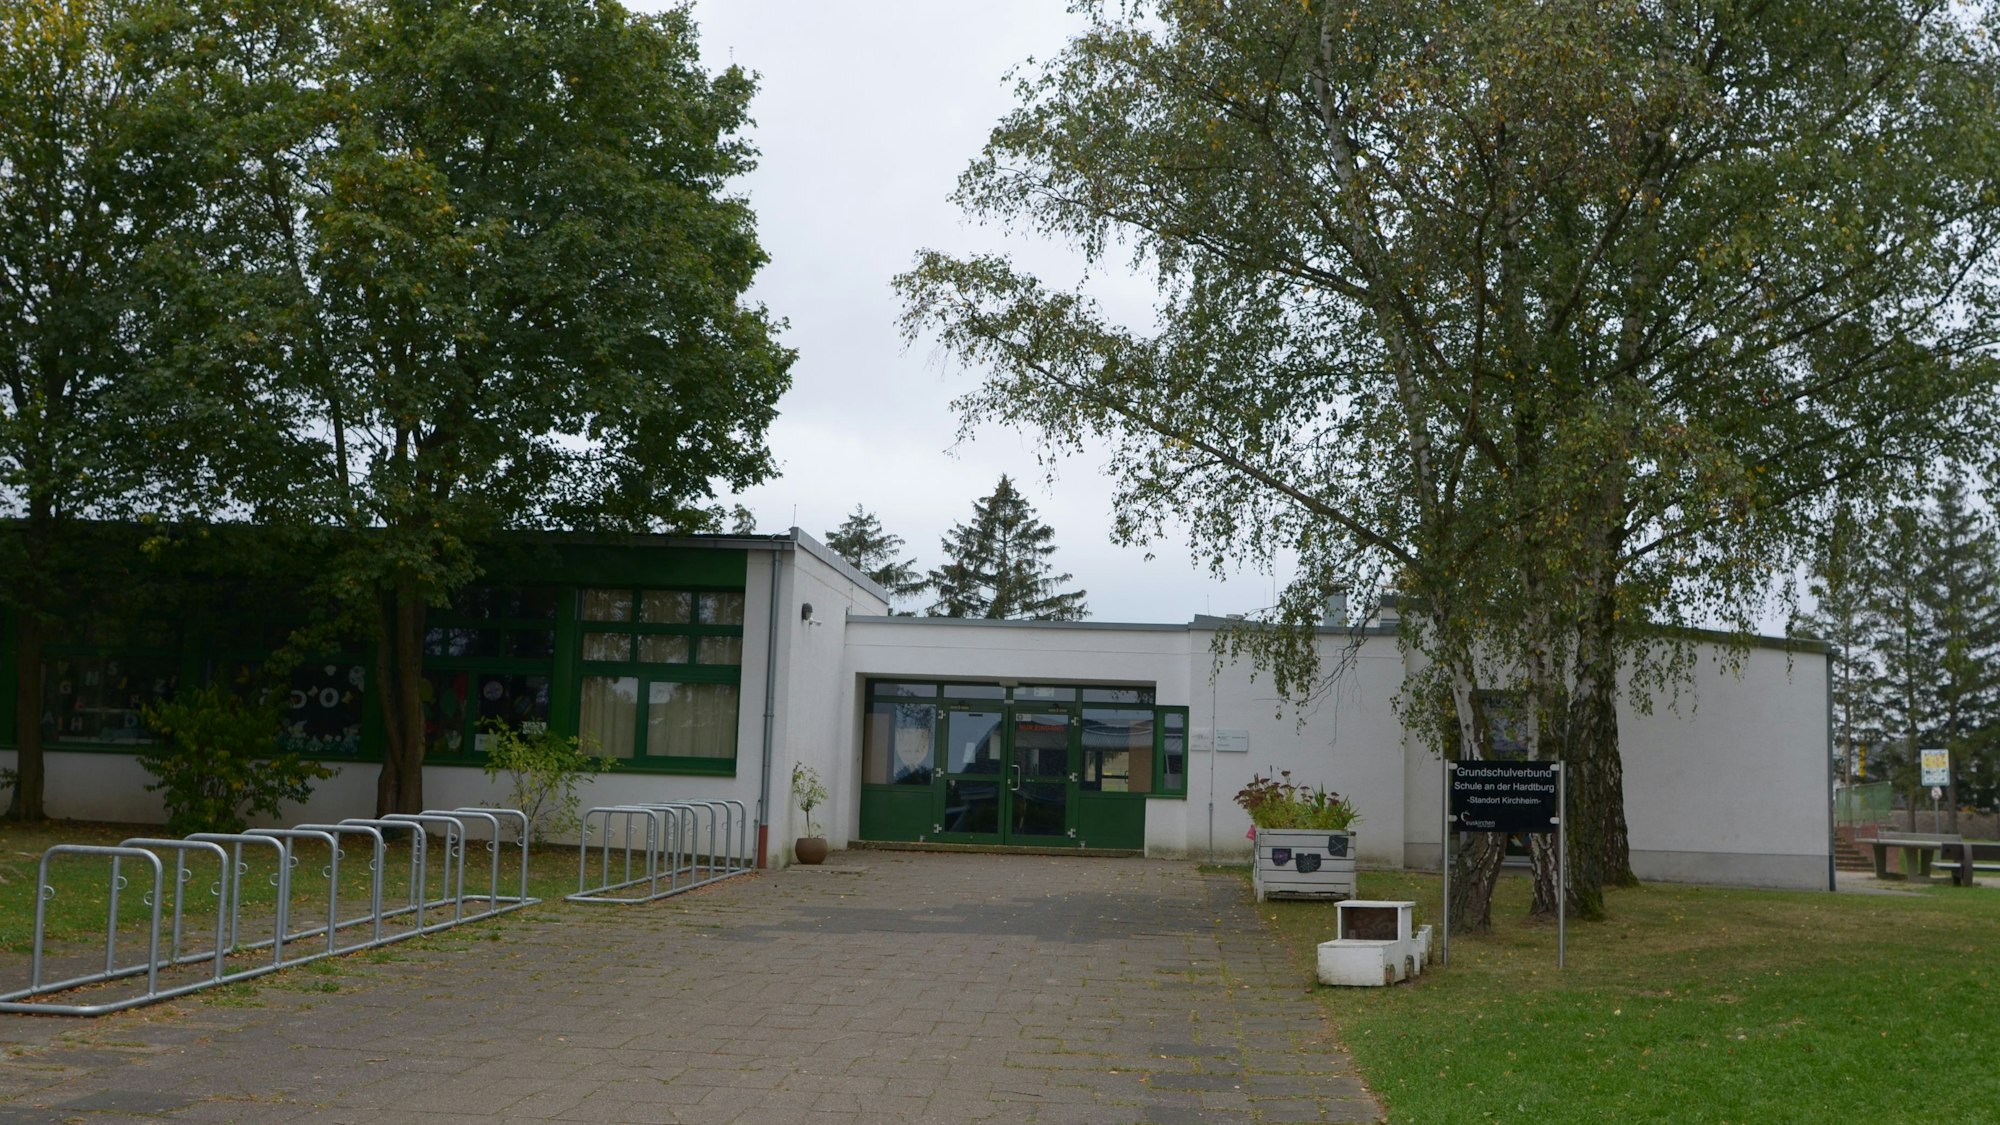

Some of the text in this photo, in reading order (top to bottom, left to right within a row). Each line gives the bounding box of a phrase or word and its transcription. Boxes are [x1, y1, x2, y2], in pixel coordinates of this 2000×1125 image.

[1456, 766, 1552, 778] Grundschulverbund
[1454, 781, 1555, 793] Schule an der Hardtburg
[1467, 796, 1542, 805] -Standort Kirchheim-
